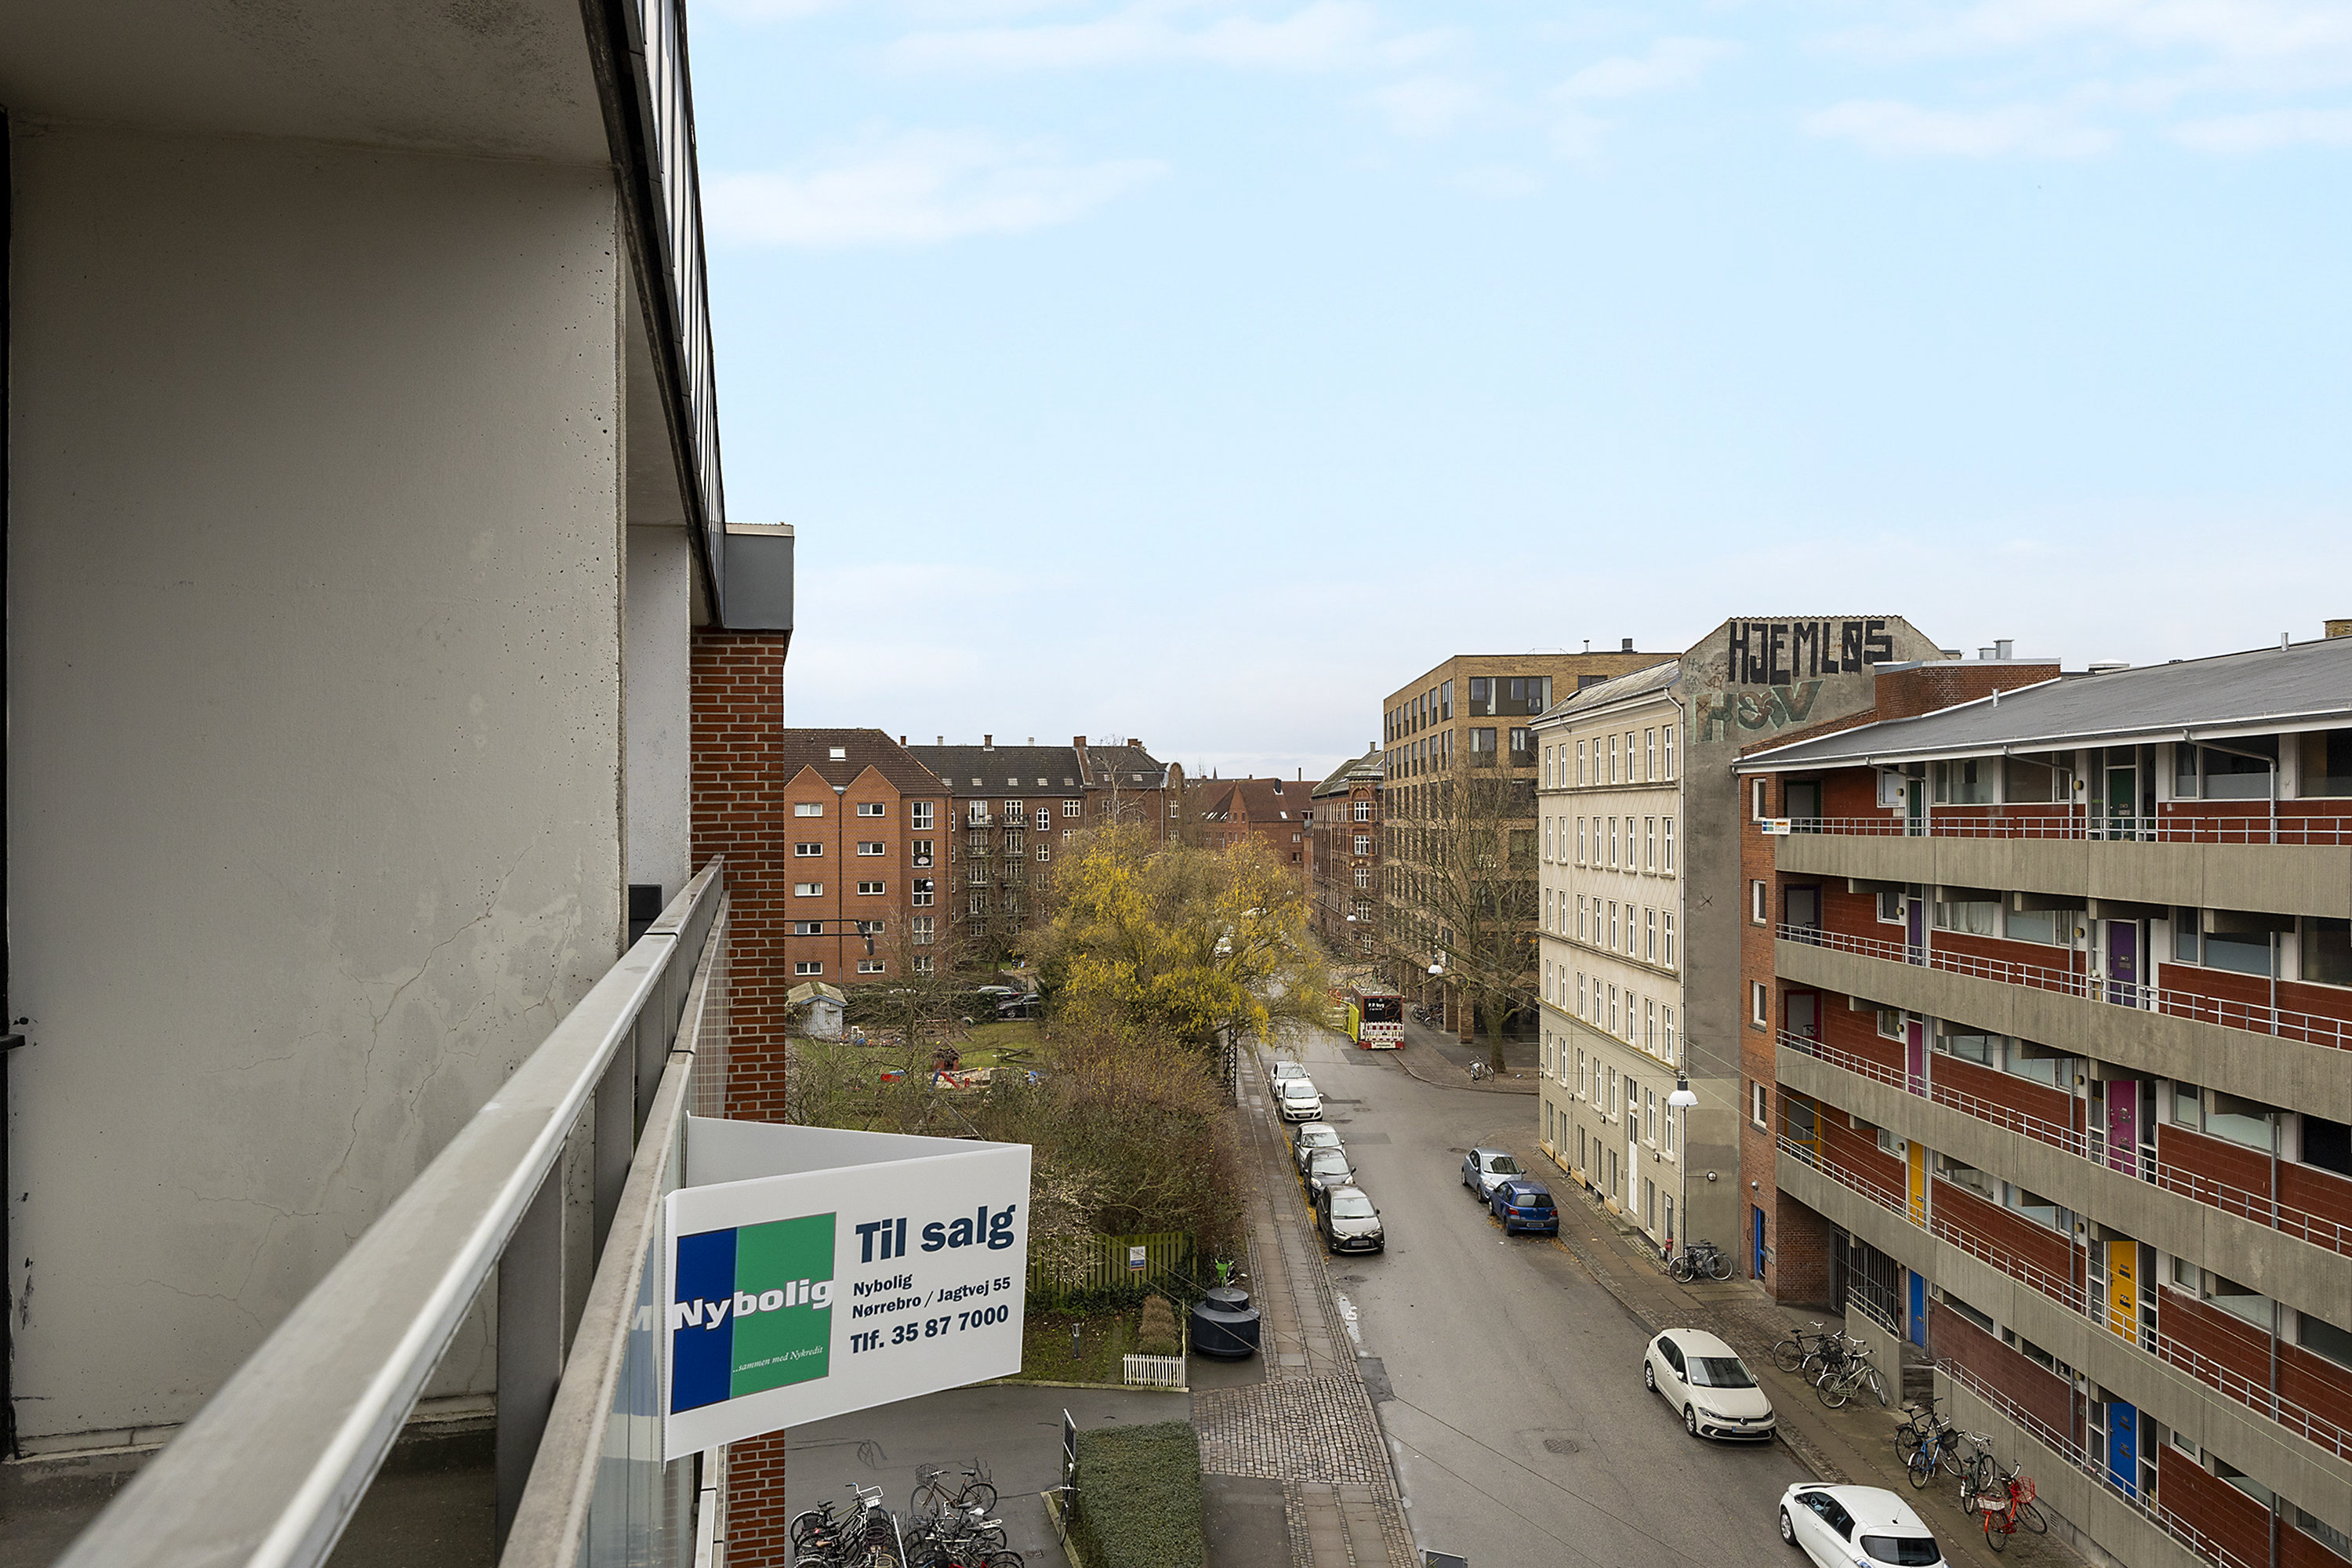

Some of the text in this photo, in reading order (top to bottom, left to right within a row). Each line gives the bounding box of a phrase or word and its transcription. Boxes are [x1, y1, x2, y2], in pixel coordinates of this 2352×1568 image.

[855, 1204, 1016, 1264] Til salg
[673, 1279, 834, 1331] Nybolig
[851, 1296, 921, 1319] Nørrebro
[937, 1280, 989, 1302] Jagtvej
[993, 1276, 1011, 1291] 55
[853, 1274, 913, 1297] Nybolig
[850, 1305, 1009, 1354] Tlf. 35 87 7000
[772, 1352, 789, 1366] med
[789, 1345, 824, 1361] Nykredit
